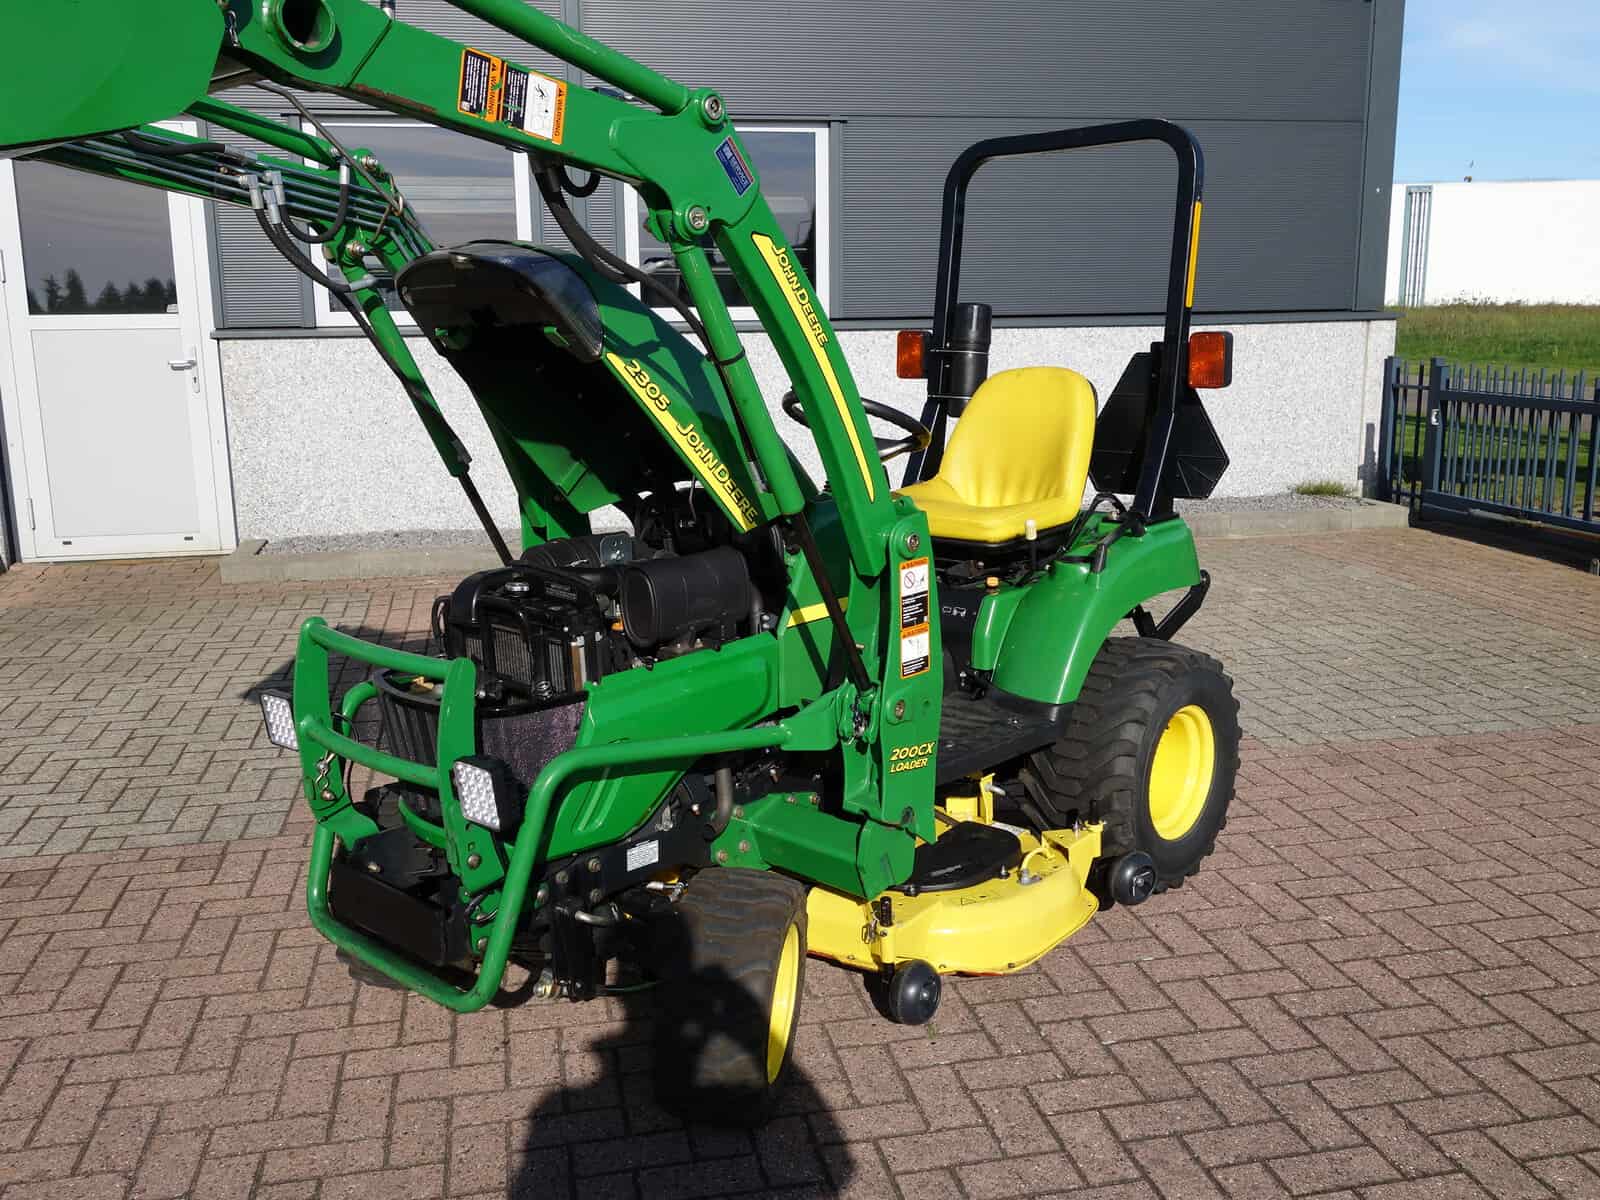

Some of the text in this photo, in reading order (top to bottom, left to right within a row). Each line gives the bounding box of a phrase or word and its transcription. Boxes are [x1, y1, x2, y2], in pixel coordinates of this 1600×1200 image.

[624, 359, 672, 412] 2305
[889, 741, 935, 761] 200CX
[889, 757, 929, 773] LOADER
